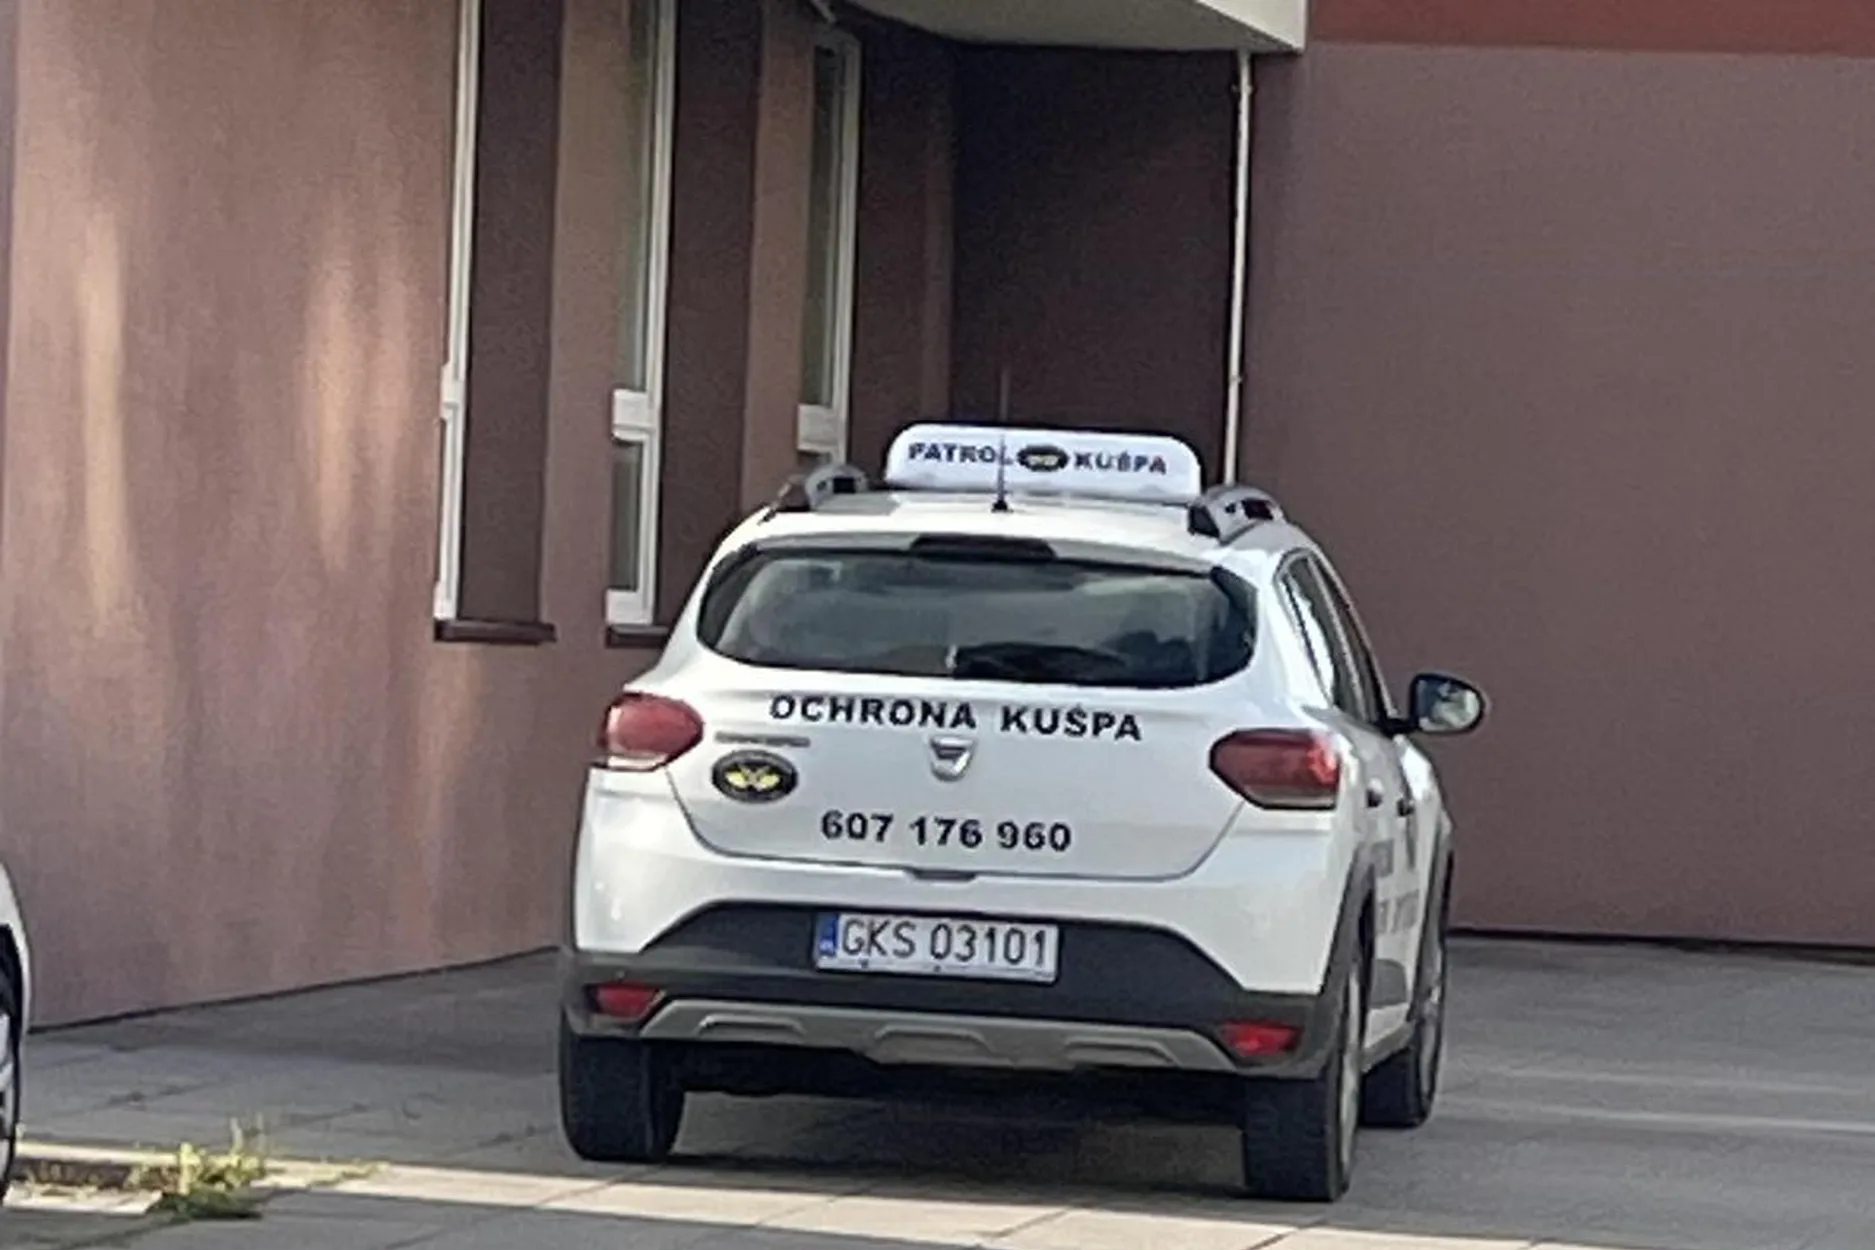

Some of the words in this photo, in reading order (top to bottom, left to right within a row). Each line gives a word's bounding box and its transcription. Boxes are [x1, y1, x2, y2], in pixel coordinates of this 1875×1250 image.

[1074, 450, 1168, 474] KUŚPA
[769, 694, 977, 729] OCHRONA
[1000, 704, 1143, 742] KUŚPA
[820, 809, 894, 843] 607
[909, 814, 983, 848] 176
[996, 820, 1072, 852] 960
[840, 919, 918, 959] GKS
[928, 923, 1047, 967] 03101
